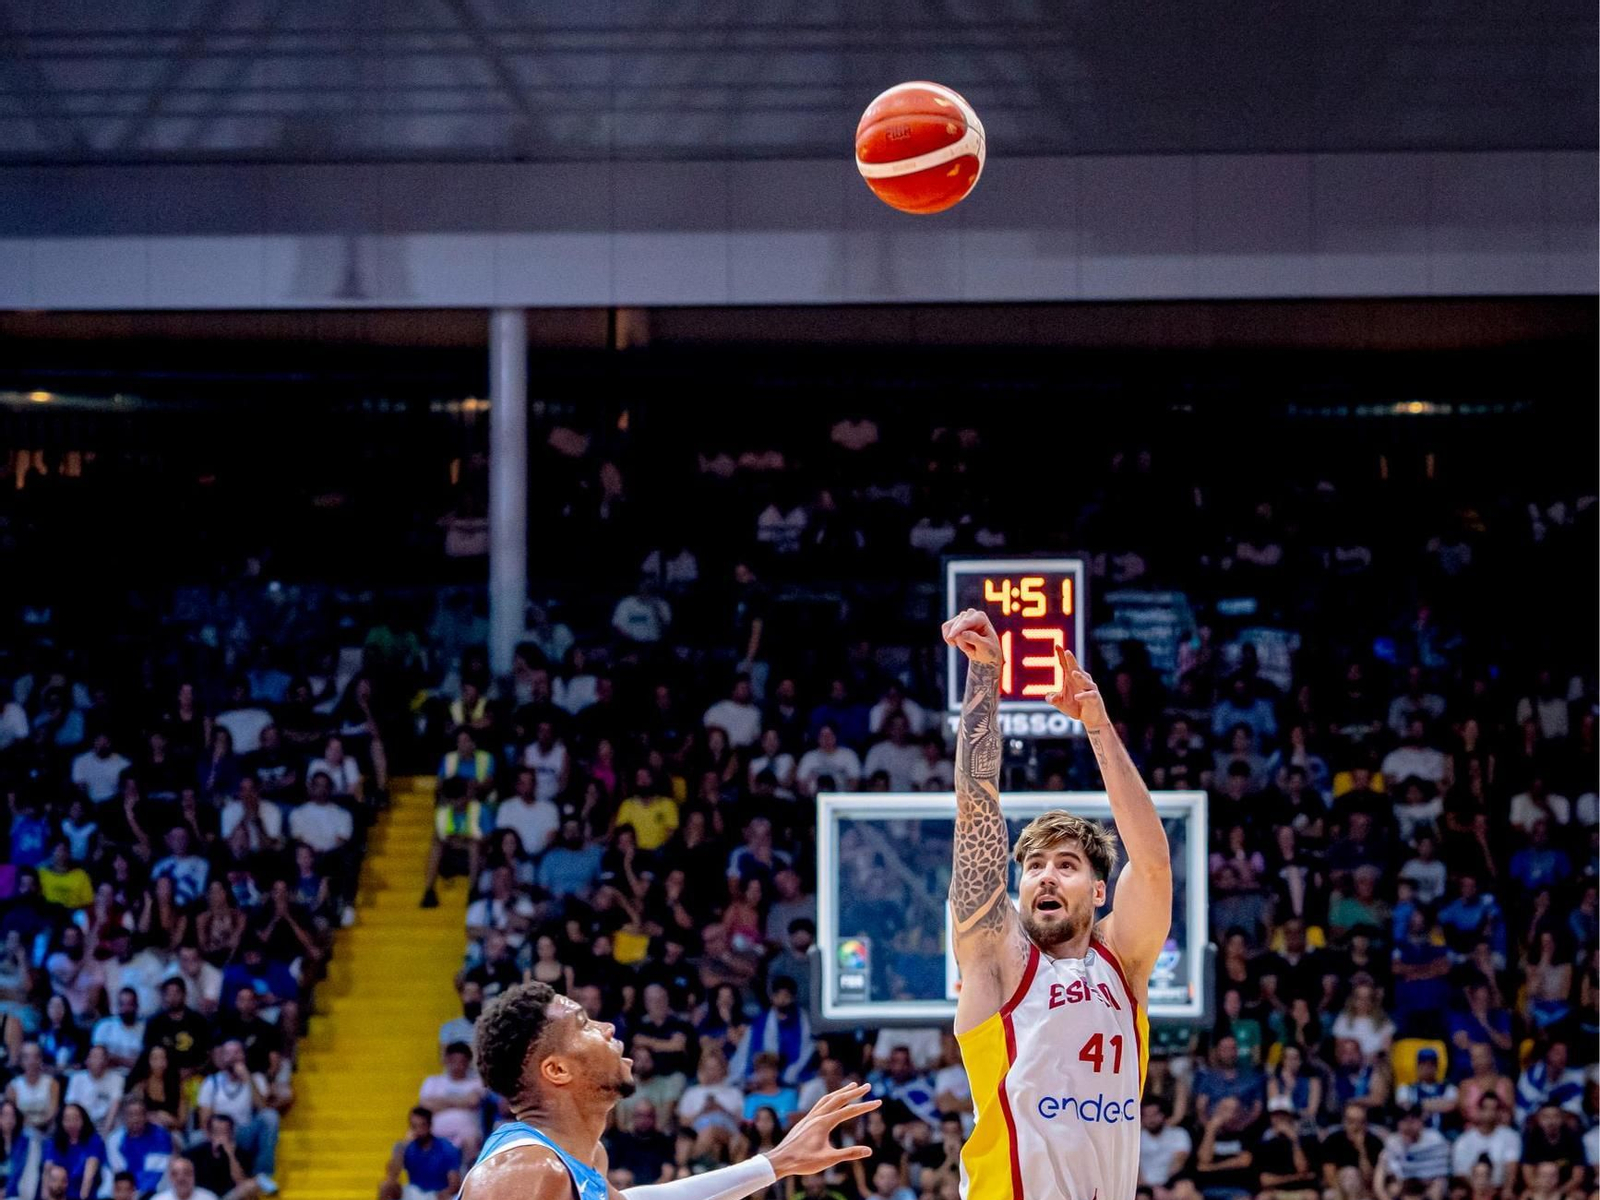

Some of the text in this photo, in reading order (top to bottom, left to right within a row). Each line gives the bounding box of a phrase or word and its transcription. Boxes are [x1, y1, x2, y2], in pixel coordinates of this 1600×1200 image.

[984, 577, 1072, 618] 4:51
[1001, 628, 1064, 695] 13
[1079, 1033, 1123, 1074] 41
